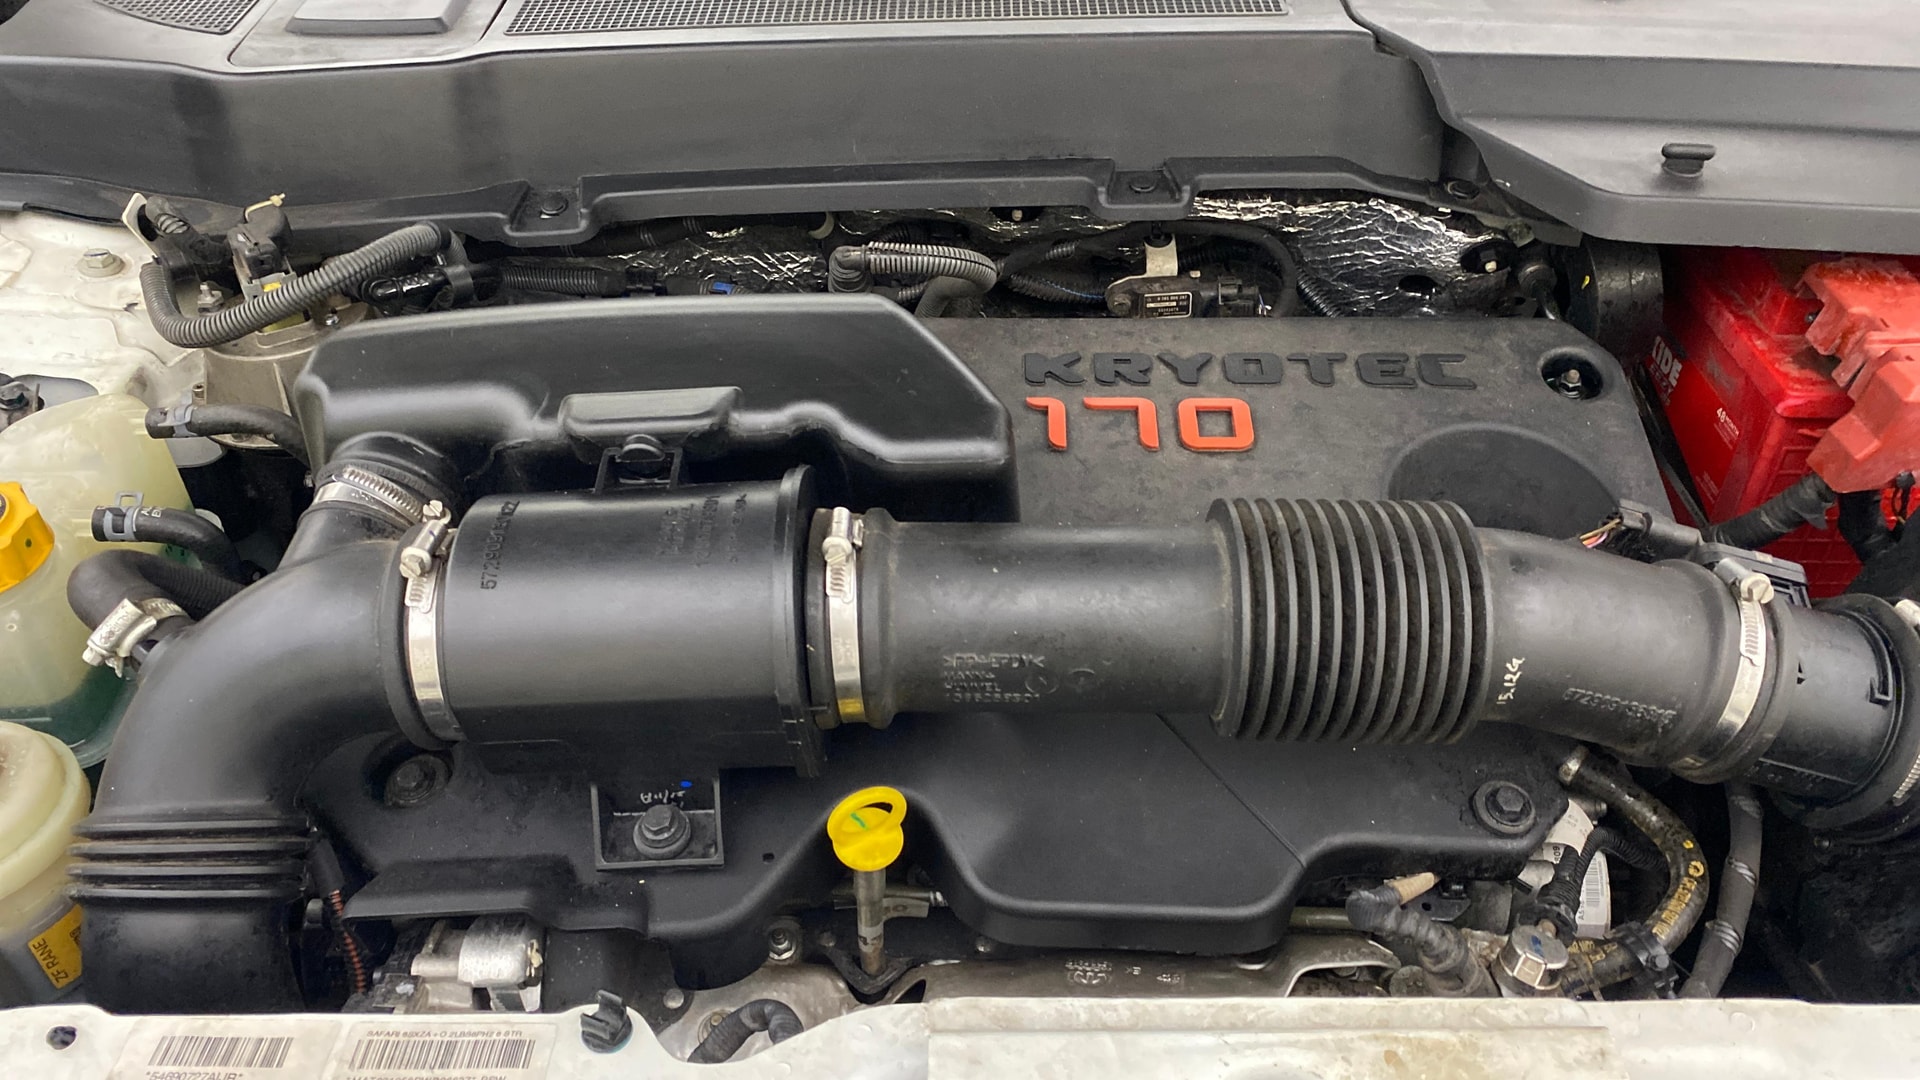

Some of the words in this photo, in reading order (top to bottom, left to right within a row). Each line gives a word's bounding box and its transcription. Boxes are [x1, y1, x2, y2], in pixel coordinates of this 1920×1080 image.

[1023, 352, 1477, 389] KRYOTEC
[1025, 396, 1256, 452] 170
[32, 937, 60, 970] RANE
[50, 968, 69, 983] ZF
[366, 1030, 401, 1038] SAFARI
